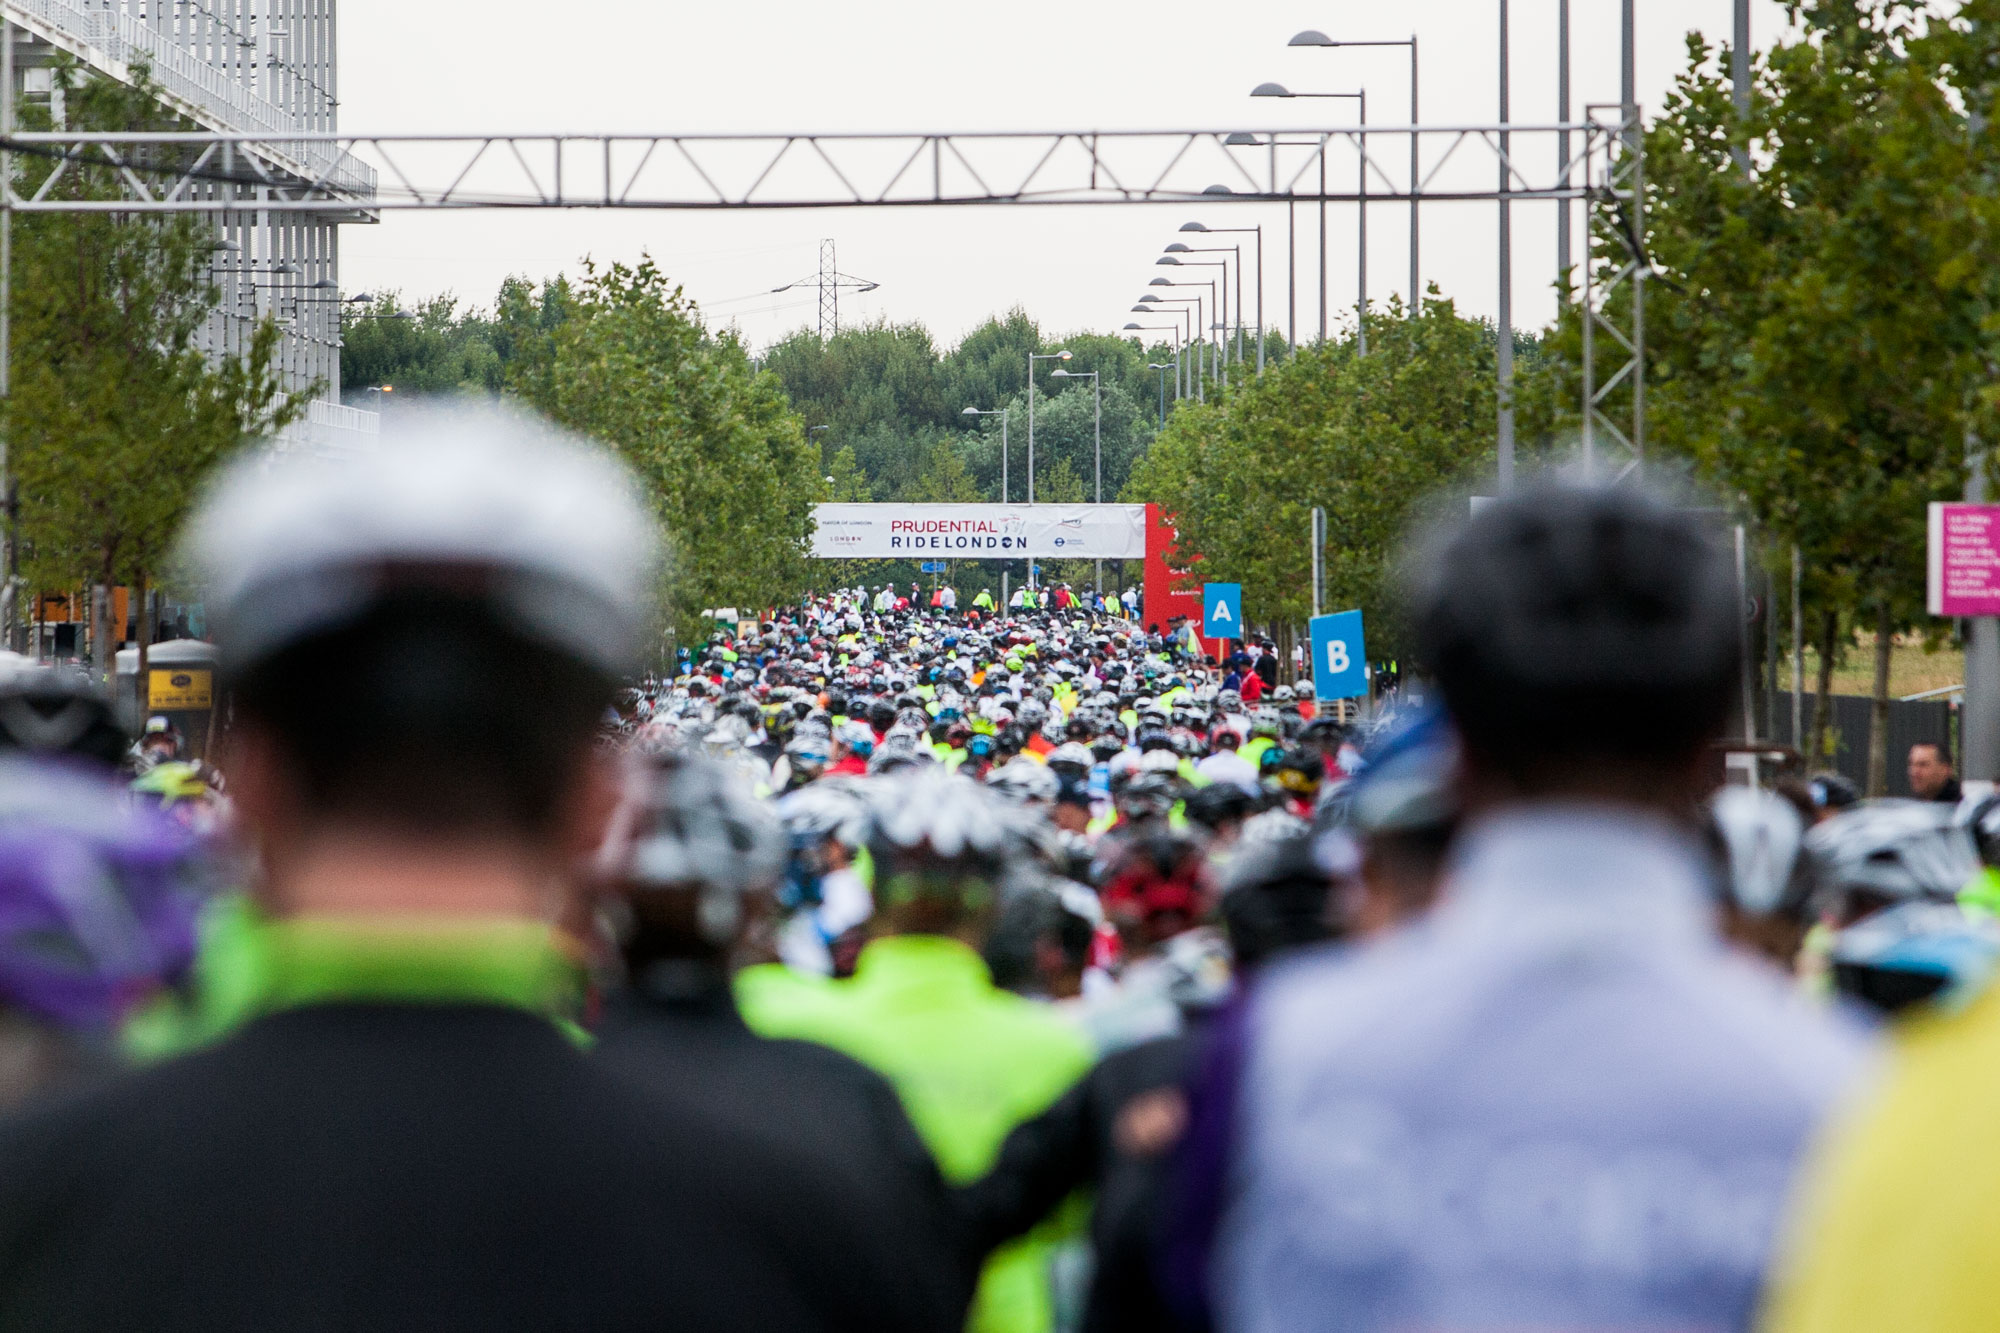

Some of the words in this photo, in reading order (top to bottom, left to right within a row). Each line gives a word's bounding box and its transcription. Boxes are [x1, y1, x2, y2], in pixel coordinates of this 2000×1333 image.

[891, 520, 998, 533] PRUDENTIAL
[891, 536, 1027, 549] RIDELONDON
[1212, 600, 1232, 622] A
[1327, 639, 1350, 674] B
